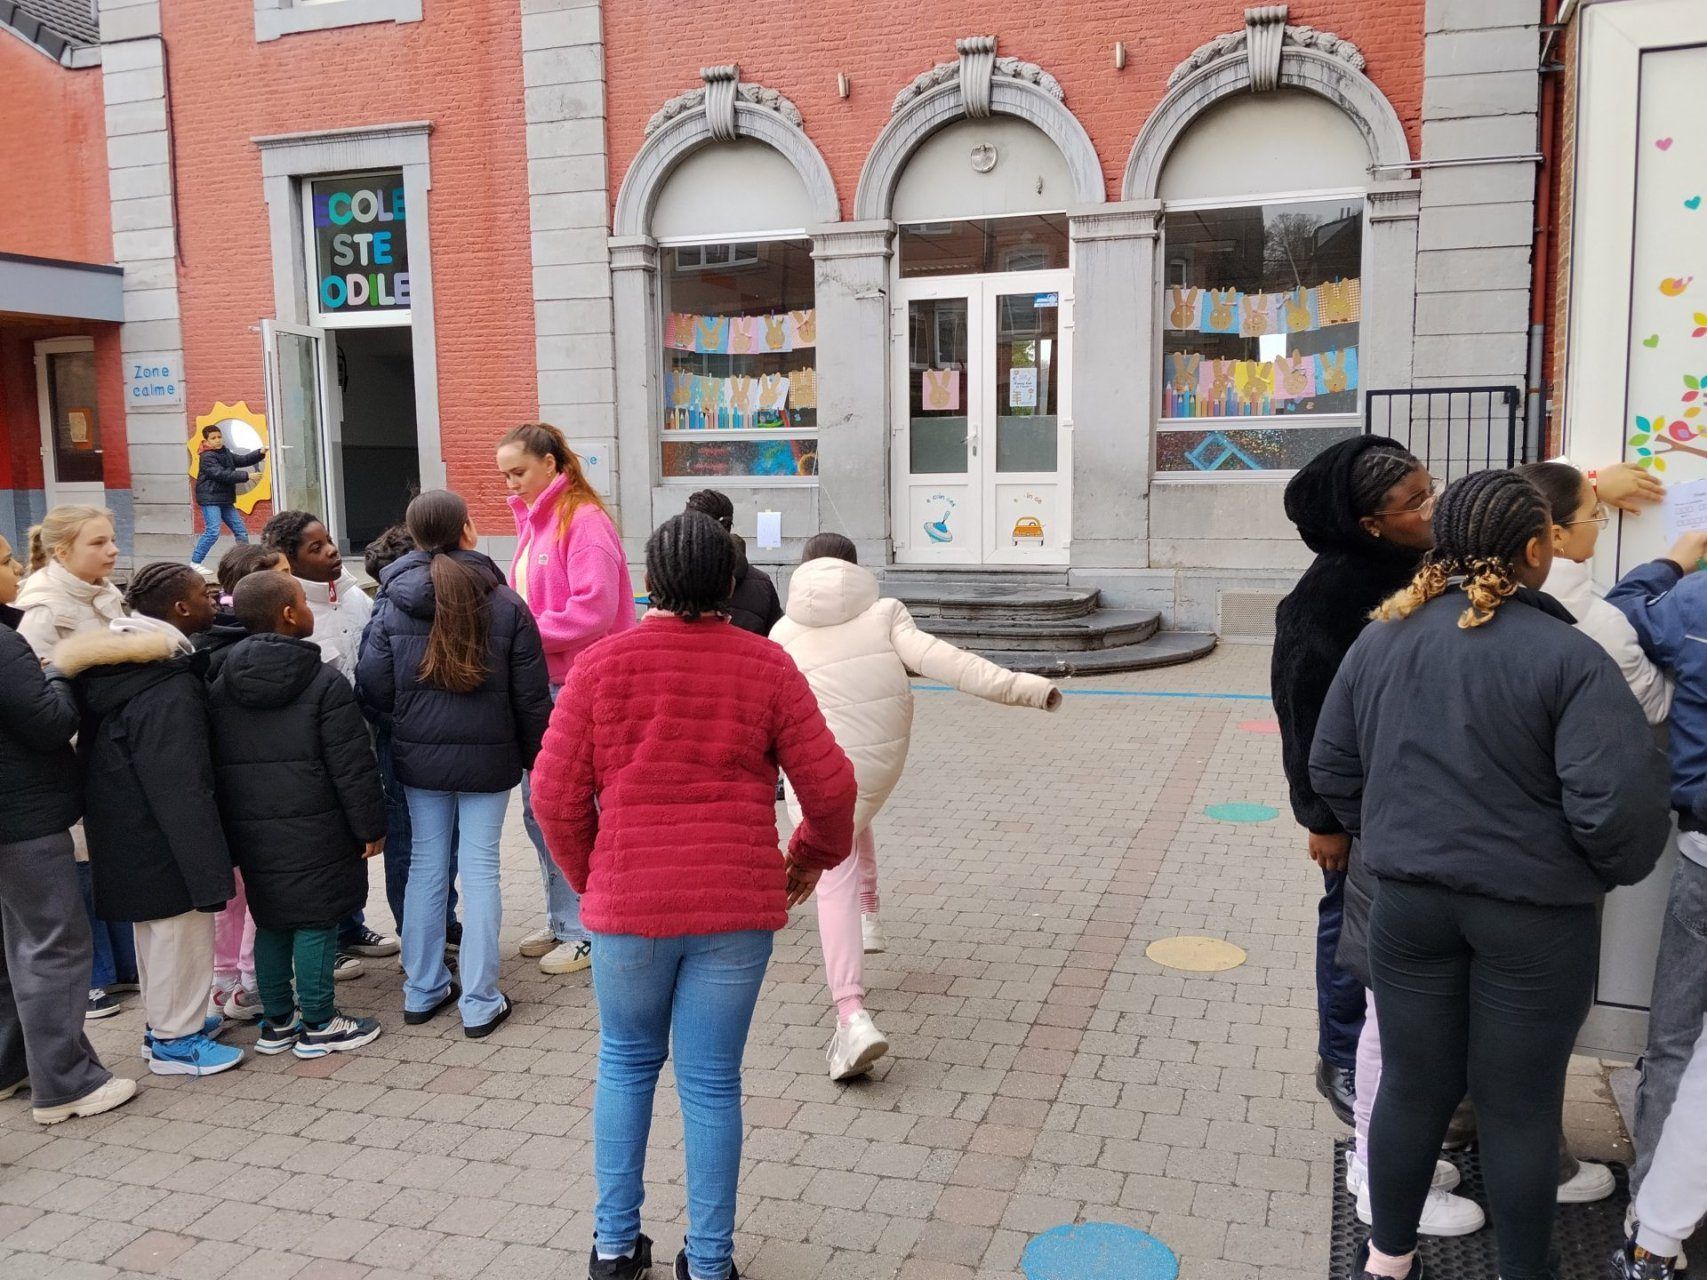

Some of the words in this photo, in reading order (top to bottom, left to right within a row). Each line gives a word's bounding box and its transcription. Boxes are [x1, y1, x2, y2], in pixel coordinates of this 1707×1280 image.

[314, 188, 405, 227] ECOLE
[333, 231, 393, 266] STE
[321, 272, 410, 308] ODILE
[134, 365, 169, 379] Zone
[133, 384, 175, 397] calme
